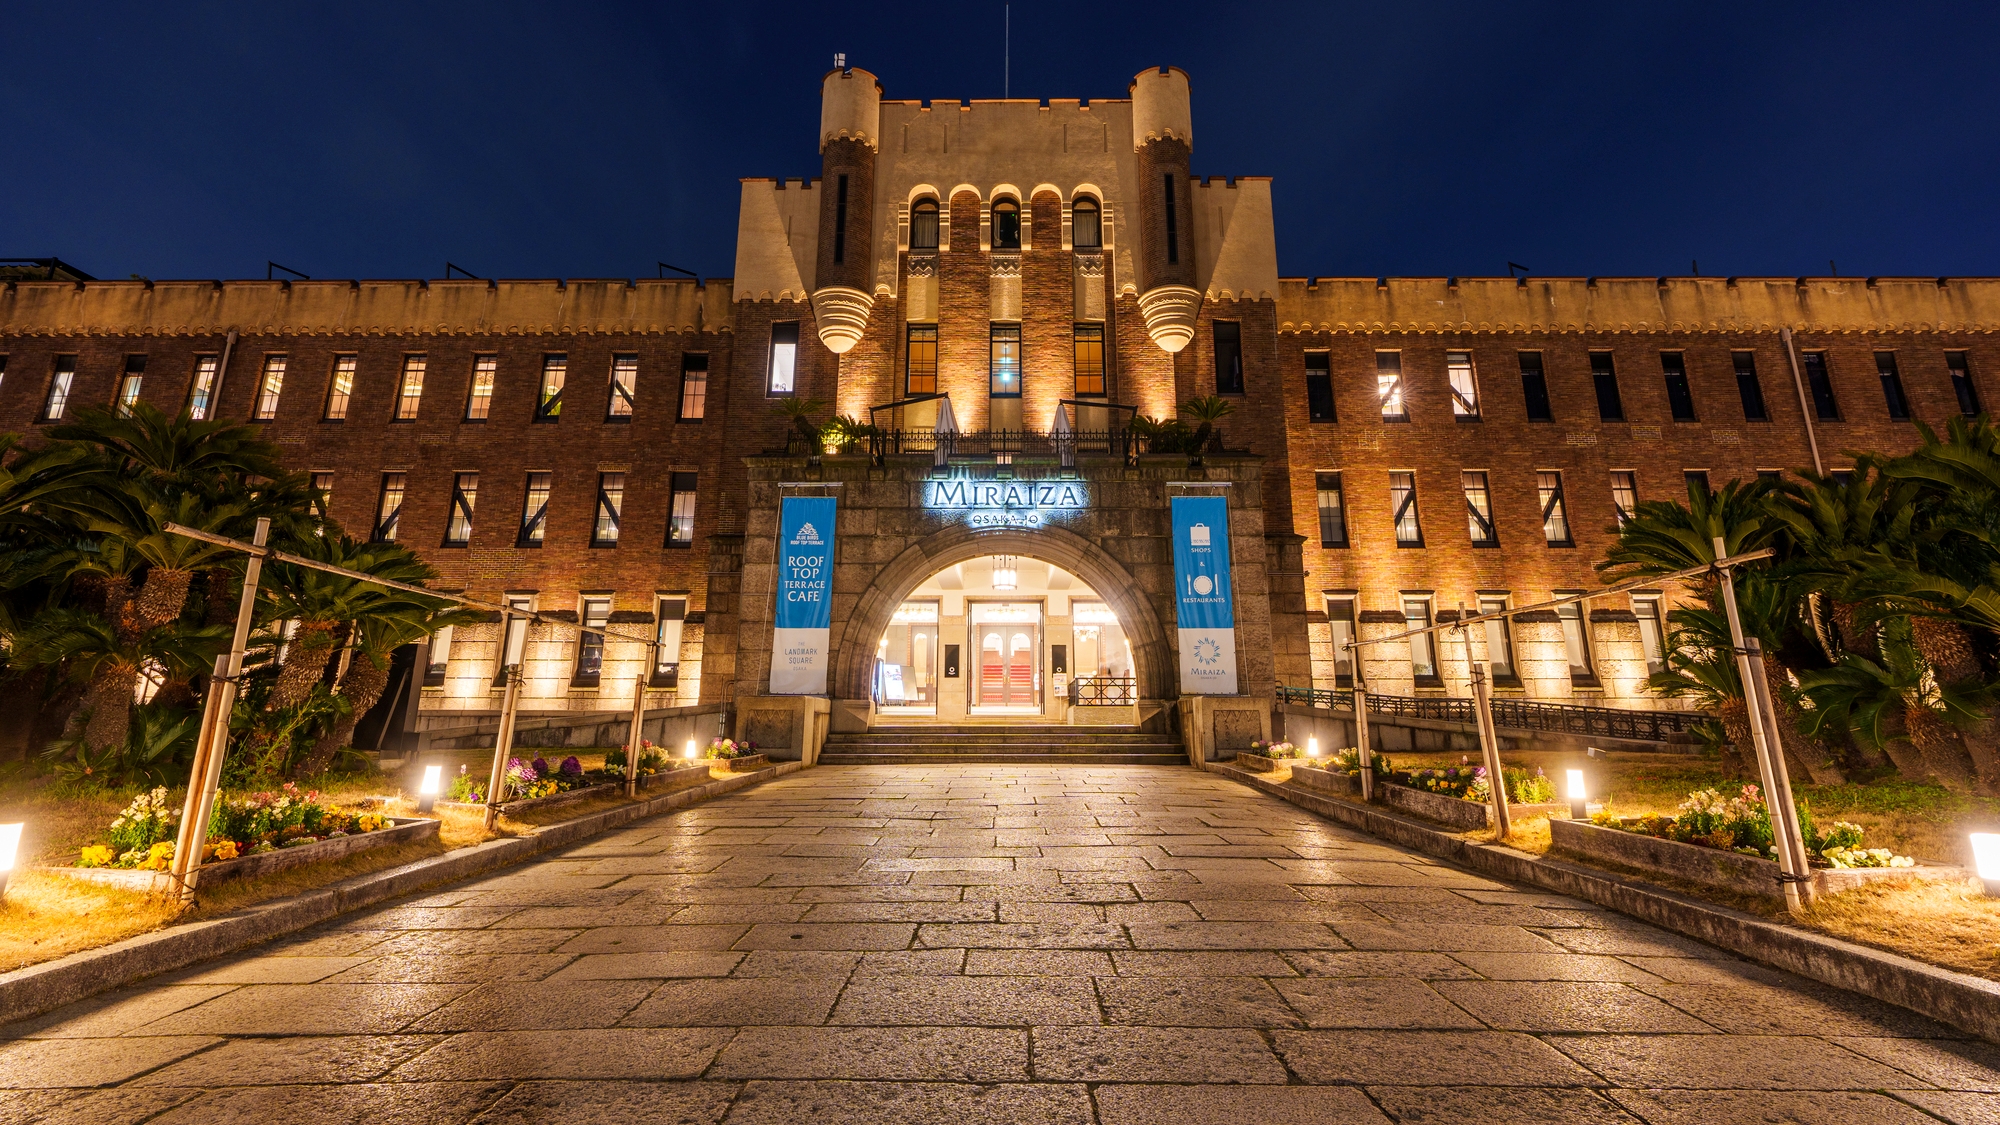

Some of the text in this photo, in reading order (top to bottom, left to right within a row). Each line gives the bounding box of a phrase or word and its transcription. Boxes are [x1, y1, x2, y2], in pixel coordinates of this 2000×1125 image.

[933, 481, 1079, 506] MIRAIZA
[973, 514, 1017, 524] OSAKA
[788, 556, 824, 567] ROOF
[792, 568, 819, 579] TOP
[785, 580, 825, 588] TERRACE
[787, 590, 820, 602] CAFE
